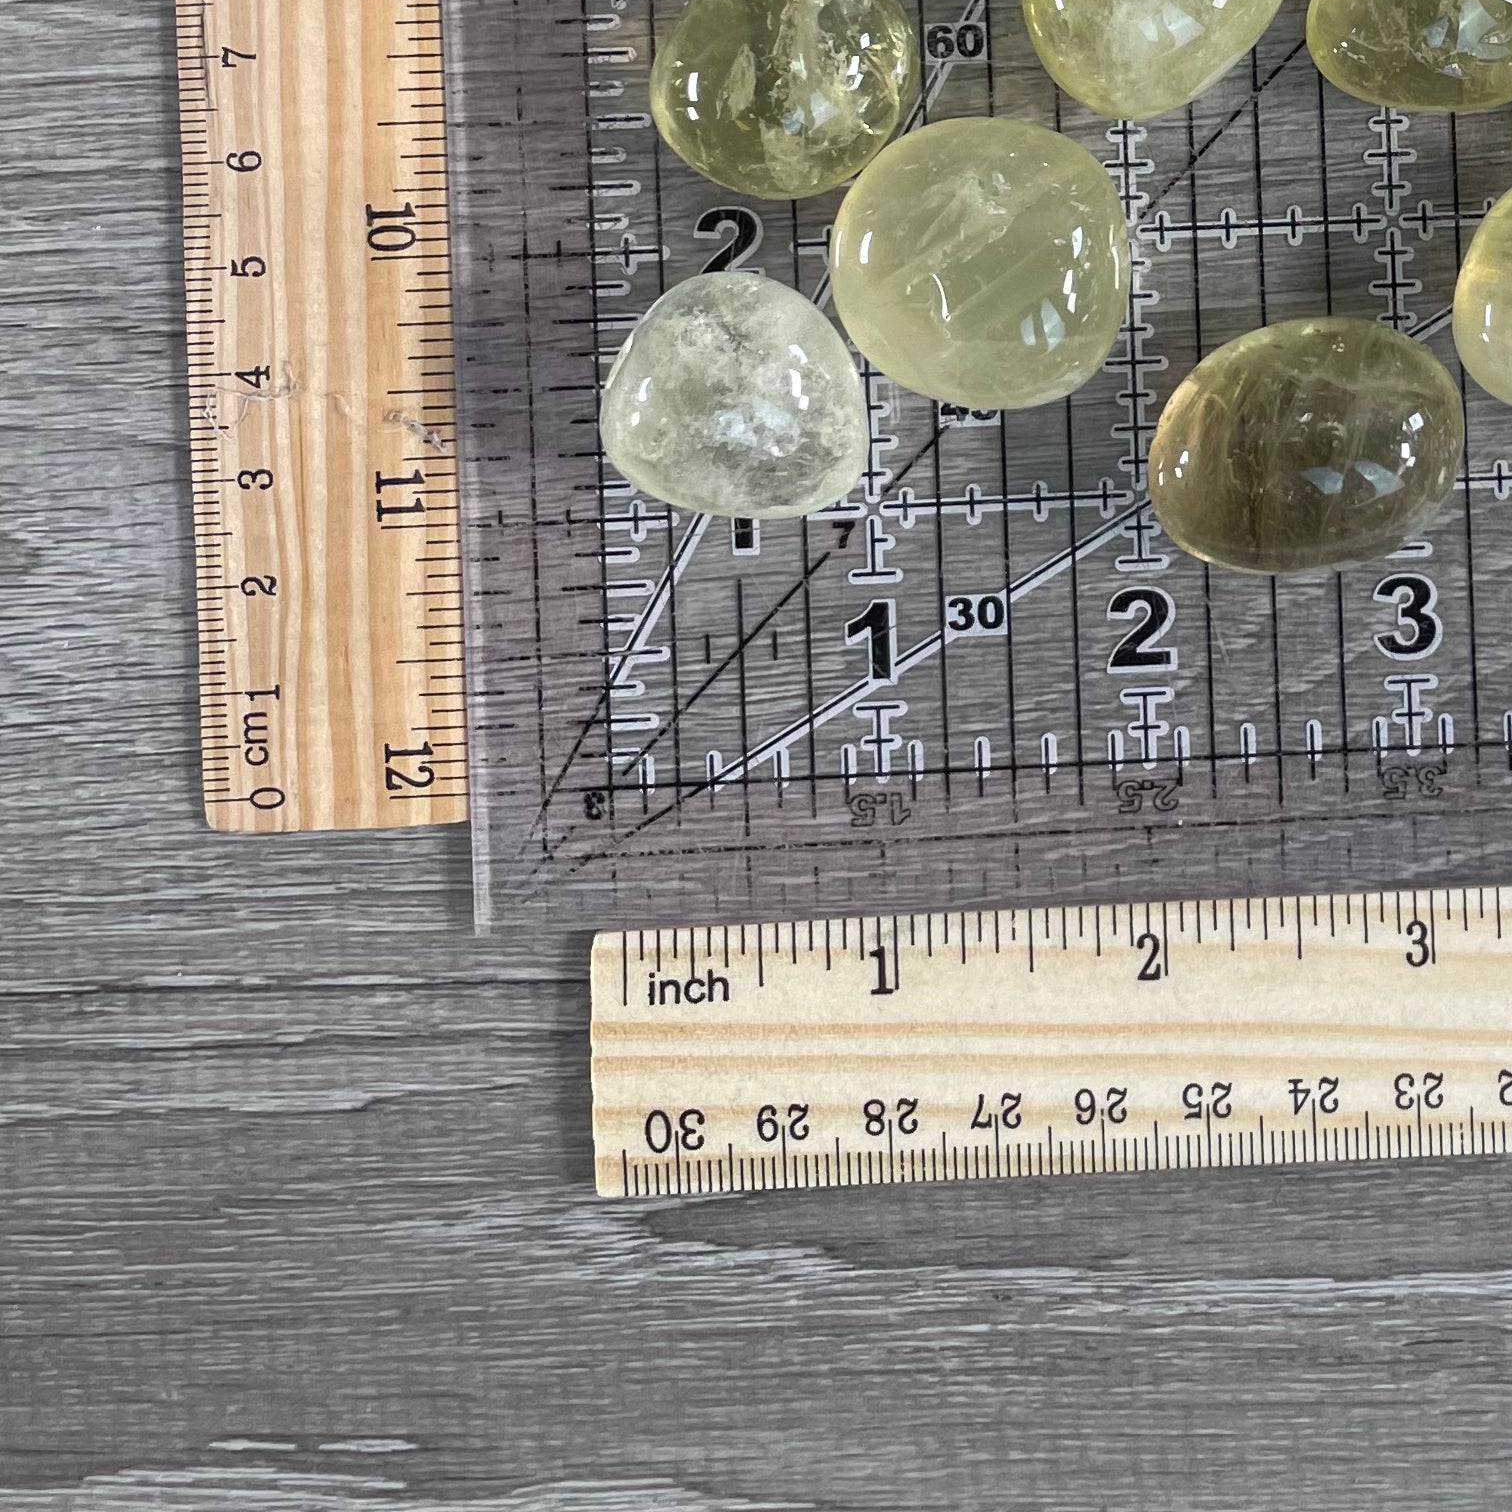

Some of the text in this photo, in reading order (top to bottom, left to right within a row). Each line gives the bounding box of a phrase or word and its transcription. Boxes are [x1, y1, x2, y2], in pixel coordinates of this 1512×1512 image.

[222, 47, 256, 67] 7
[927, 24, 984, 57] 60
[227, 151, 262, 172] 6
[366, 203, 416, 251] 10
[694, 206, 765, 276] 2
[230, 257, 266, 277] 5
[235, 365, 270, 387] 4
[237, 469, 273, 489] 3
[376, 470, 425, 522] 11
[831, 522, 855, 547] 7
[241, 575, 277, 596] 2
[947, 598, 1001, 630] 30
[1107, 586, 1178, 674] 2
[1373, 573, 1443, 661] 3
[844, 599, 897, 684] 1
[245, 684, 280, 701] 1
[245, 711, 268, 766] cm
[385, 741, 434, 790] 12
[250, 787, 285, 809] 0
[1137, 933, 1161, 980] 2
[1405, 920, 1430, 966] 3
[647, 969, 729, 1005] inch
[870, 946, 893, 994] 1
[1075, 1087, 1127, 1125] 26
[1183, 1082, 1232, 1119] 25
[1289, 1077, 1339, 1114] 24
[1394, 1072, 1444, 1110] 23
[757, 1104, 810, 1143] 29
[863, 1098, 918, 1135] 28
[971, 1093, 1022, 1130] 27
[645, 1109, 705, 1154] 30
